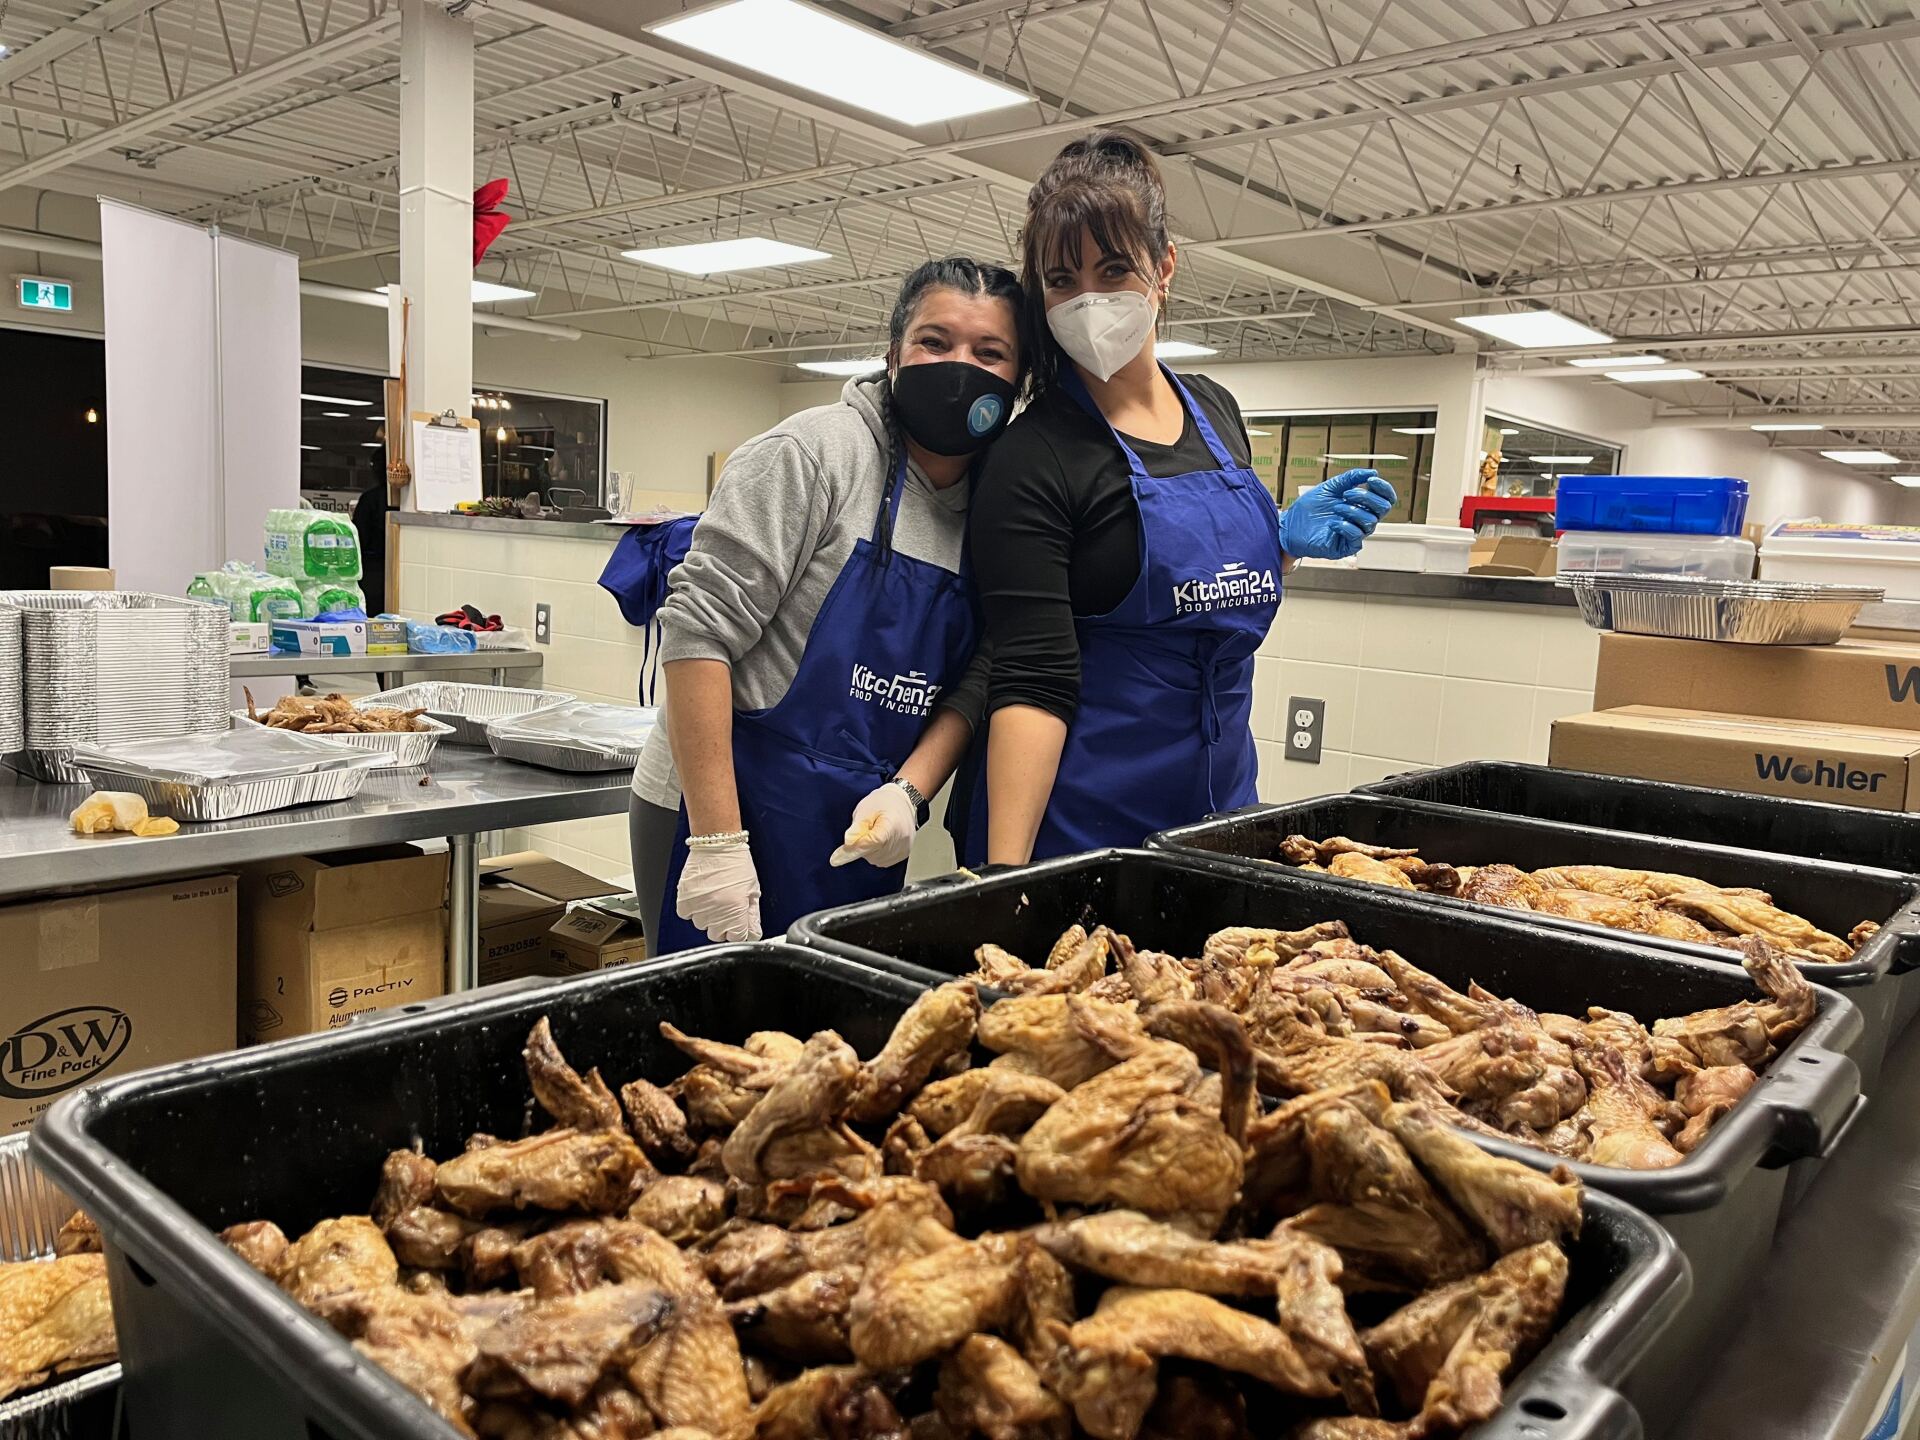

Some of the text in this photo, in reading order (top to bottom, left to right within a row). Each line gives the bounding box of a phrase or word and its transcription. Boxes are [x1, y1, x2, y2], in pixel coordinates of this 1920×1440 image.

[978, 405, 996, 425] N
[1173, 568, 1276, 606] Kitchen24
[1176, 593, 1277, 615] FOOD INCUBATOR
[849, 687, 872, 702] FOOD
[1754, 753, 1887, 793] Wohler
[353, 978, 414, 998] PACTIV
[20, 1055, 102, 1084] Fine Pack
